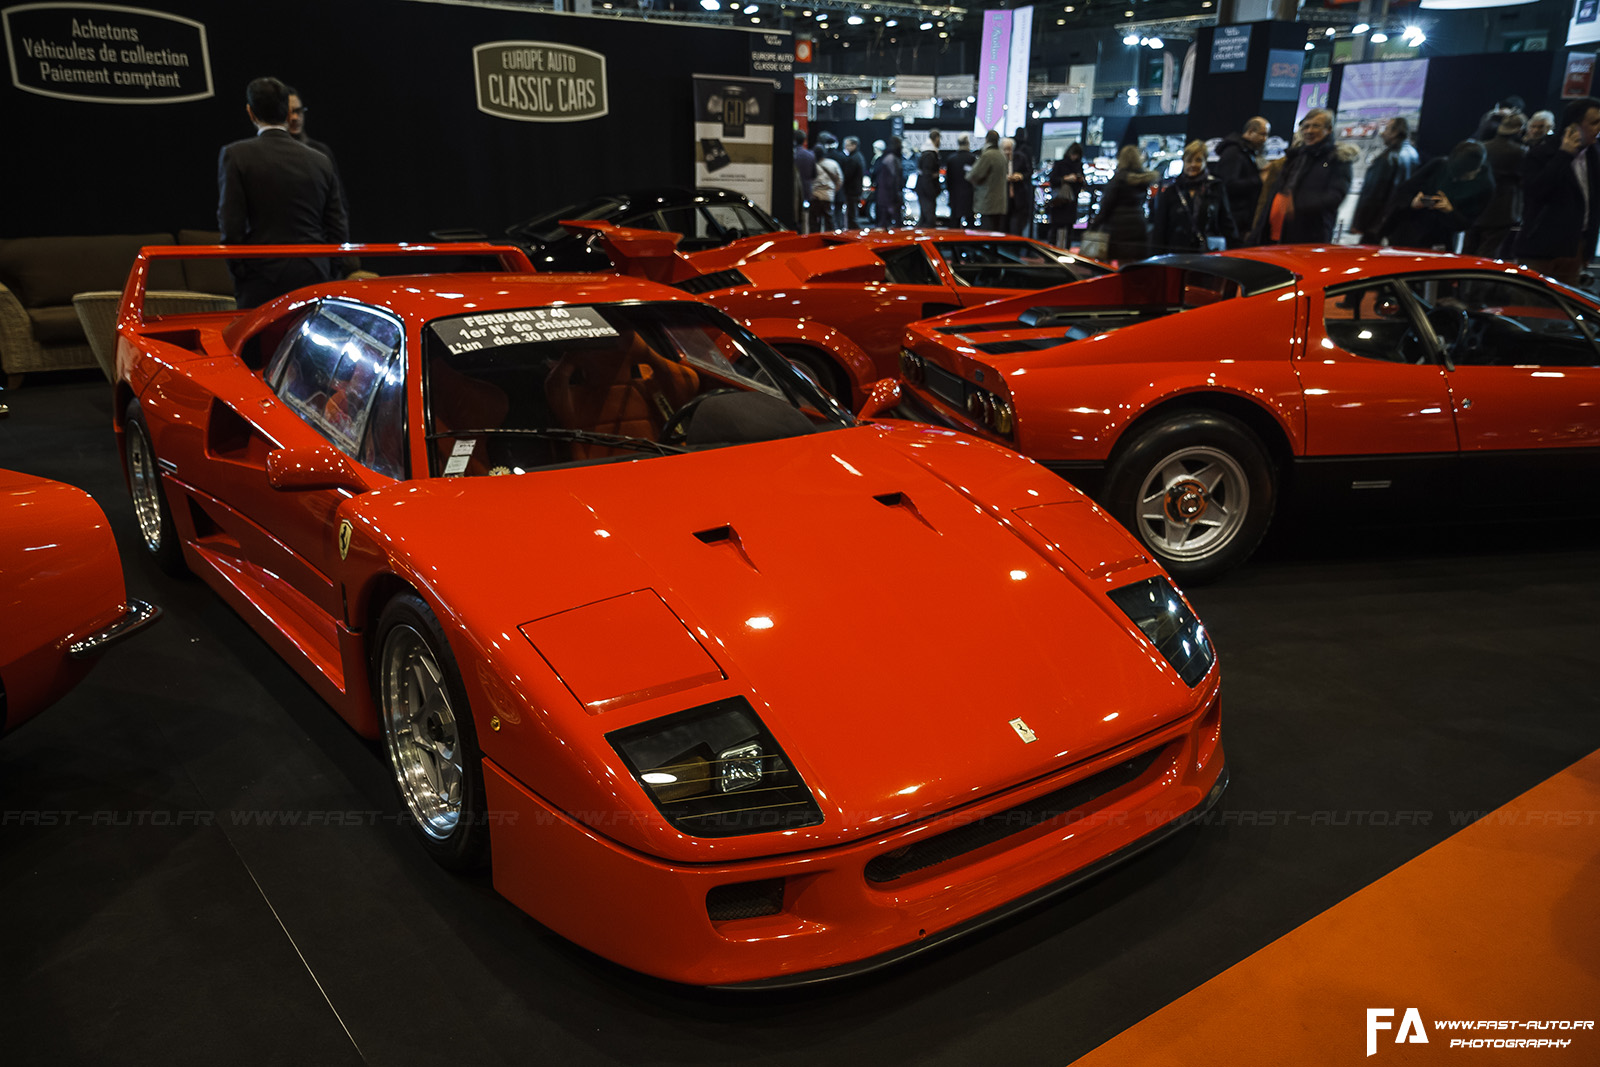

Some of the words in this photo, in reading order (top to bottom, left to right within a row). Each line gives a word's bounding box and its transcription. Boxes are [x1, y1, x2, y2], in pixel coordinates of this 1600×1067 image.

[72, 17, 139, 42] Achetons
[22, 37, 95, 62] Véhicules
[100, 43, 117, 63] de
[121, 44, 189, 67] collection
[501, 49, 544, 71] EUROPE
[547, 51, 576, 73] AUTO
[752, 51, 776, 62] EUROPE
[777, 53, 795, 63] AUTO
[40, 61, 110, 84] Paiement
[113, 71, 181, 89] comptant
[753, 61, 778, 71] CLASSIC
[488, 74, 553, 112] CLASSIC
[557, 78, 596, 112] CARS
[459, 325, 487, 341] 1er
[513, 321, 533, 333] de
[535, 316, 592, 331] châssis
[463, 310, 535, 328] FERRARI
[535, 309, 547, 320] F
[549, 307, 570, 319] 40
[448, 341, 483, 355] L'un
[493, 334, 521, 347] des
[525, 331, 541, 343] 30
[543, 325, 617, 343] prototypes
